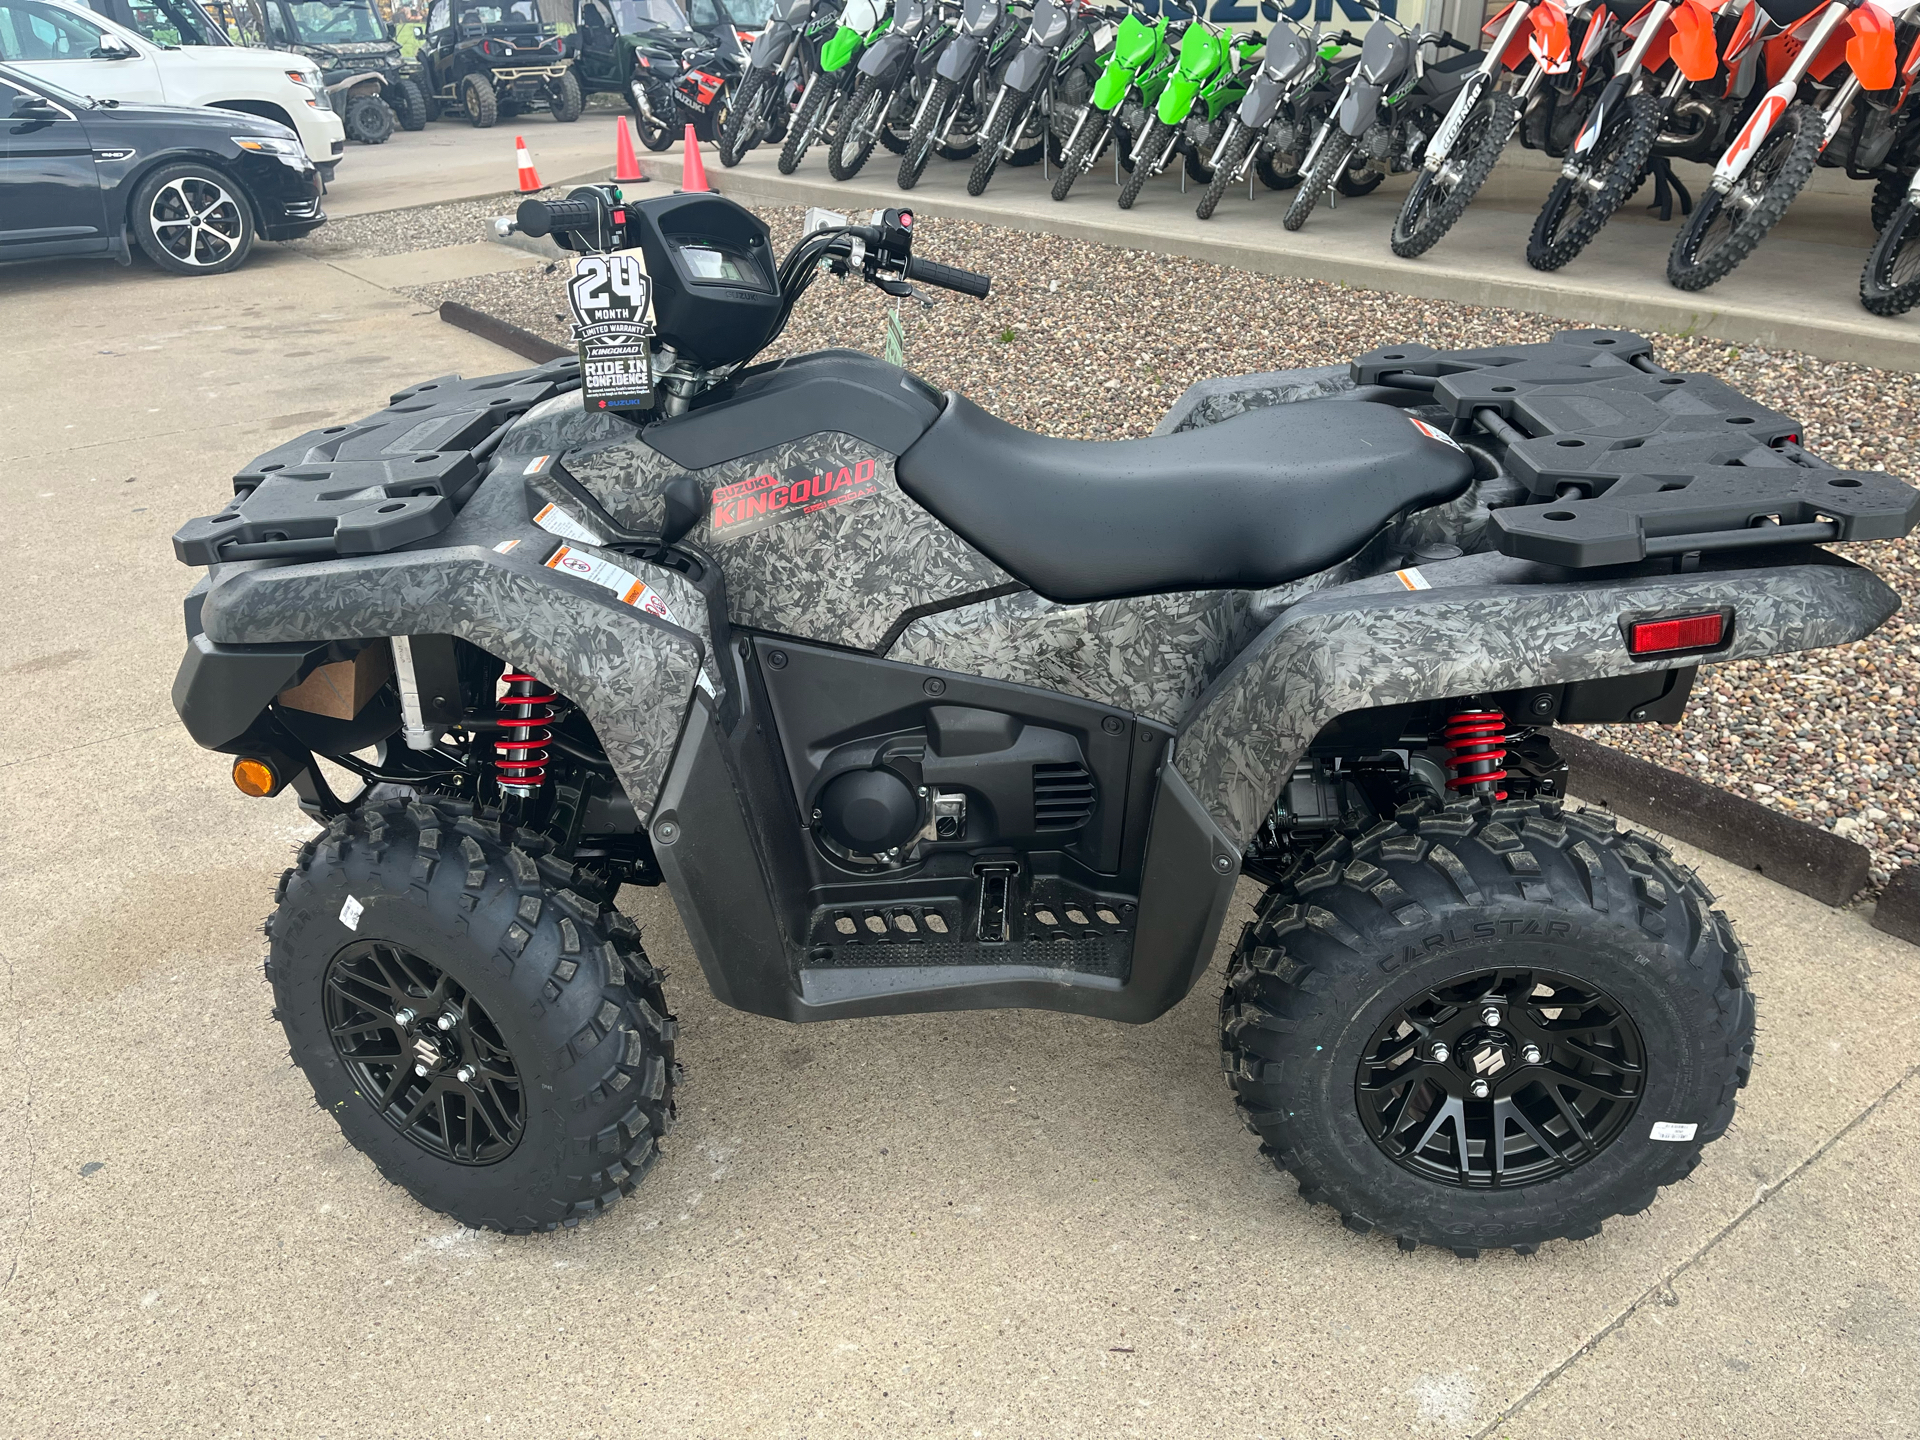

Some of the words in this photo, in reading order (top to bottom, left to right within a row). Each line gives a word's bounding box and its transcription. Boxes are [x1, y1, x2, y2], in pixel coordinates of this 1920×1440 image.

[674, 89, 706, 114] SUZUKI
[576, 256, 645, 310] 24
[594, 308, 630, 320] MONTH
[581, 325, 609, 338] LIMITED
[609, 324, 646, 335] WARRANTY
[591, 346, 639, 356] KINGQUAD
[584, 360, 625, 376] RIDE
[627, 359, 648, 373] IN
[585, 372, 649, 388] CONFIDENCE
[607, 398, 641, 407] SUZUKI
[713, 458, 876, 529] KINGQUAD
[714, 475, 771, 501] SUZUKI
[1376, 917, 1573, 975] CARLSTAR
